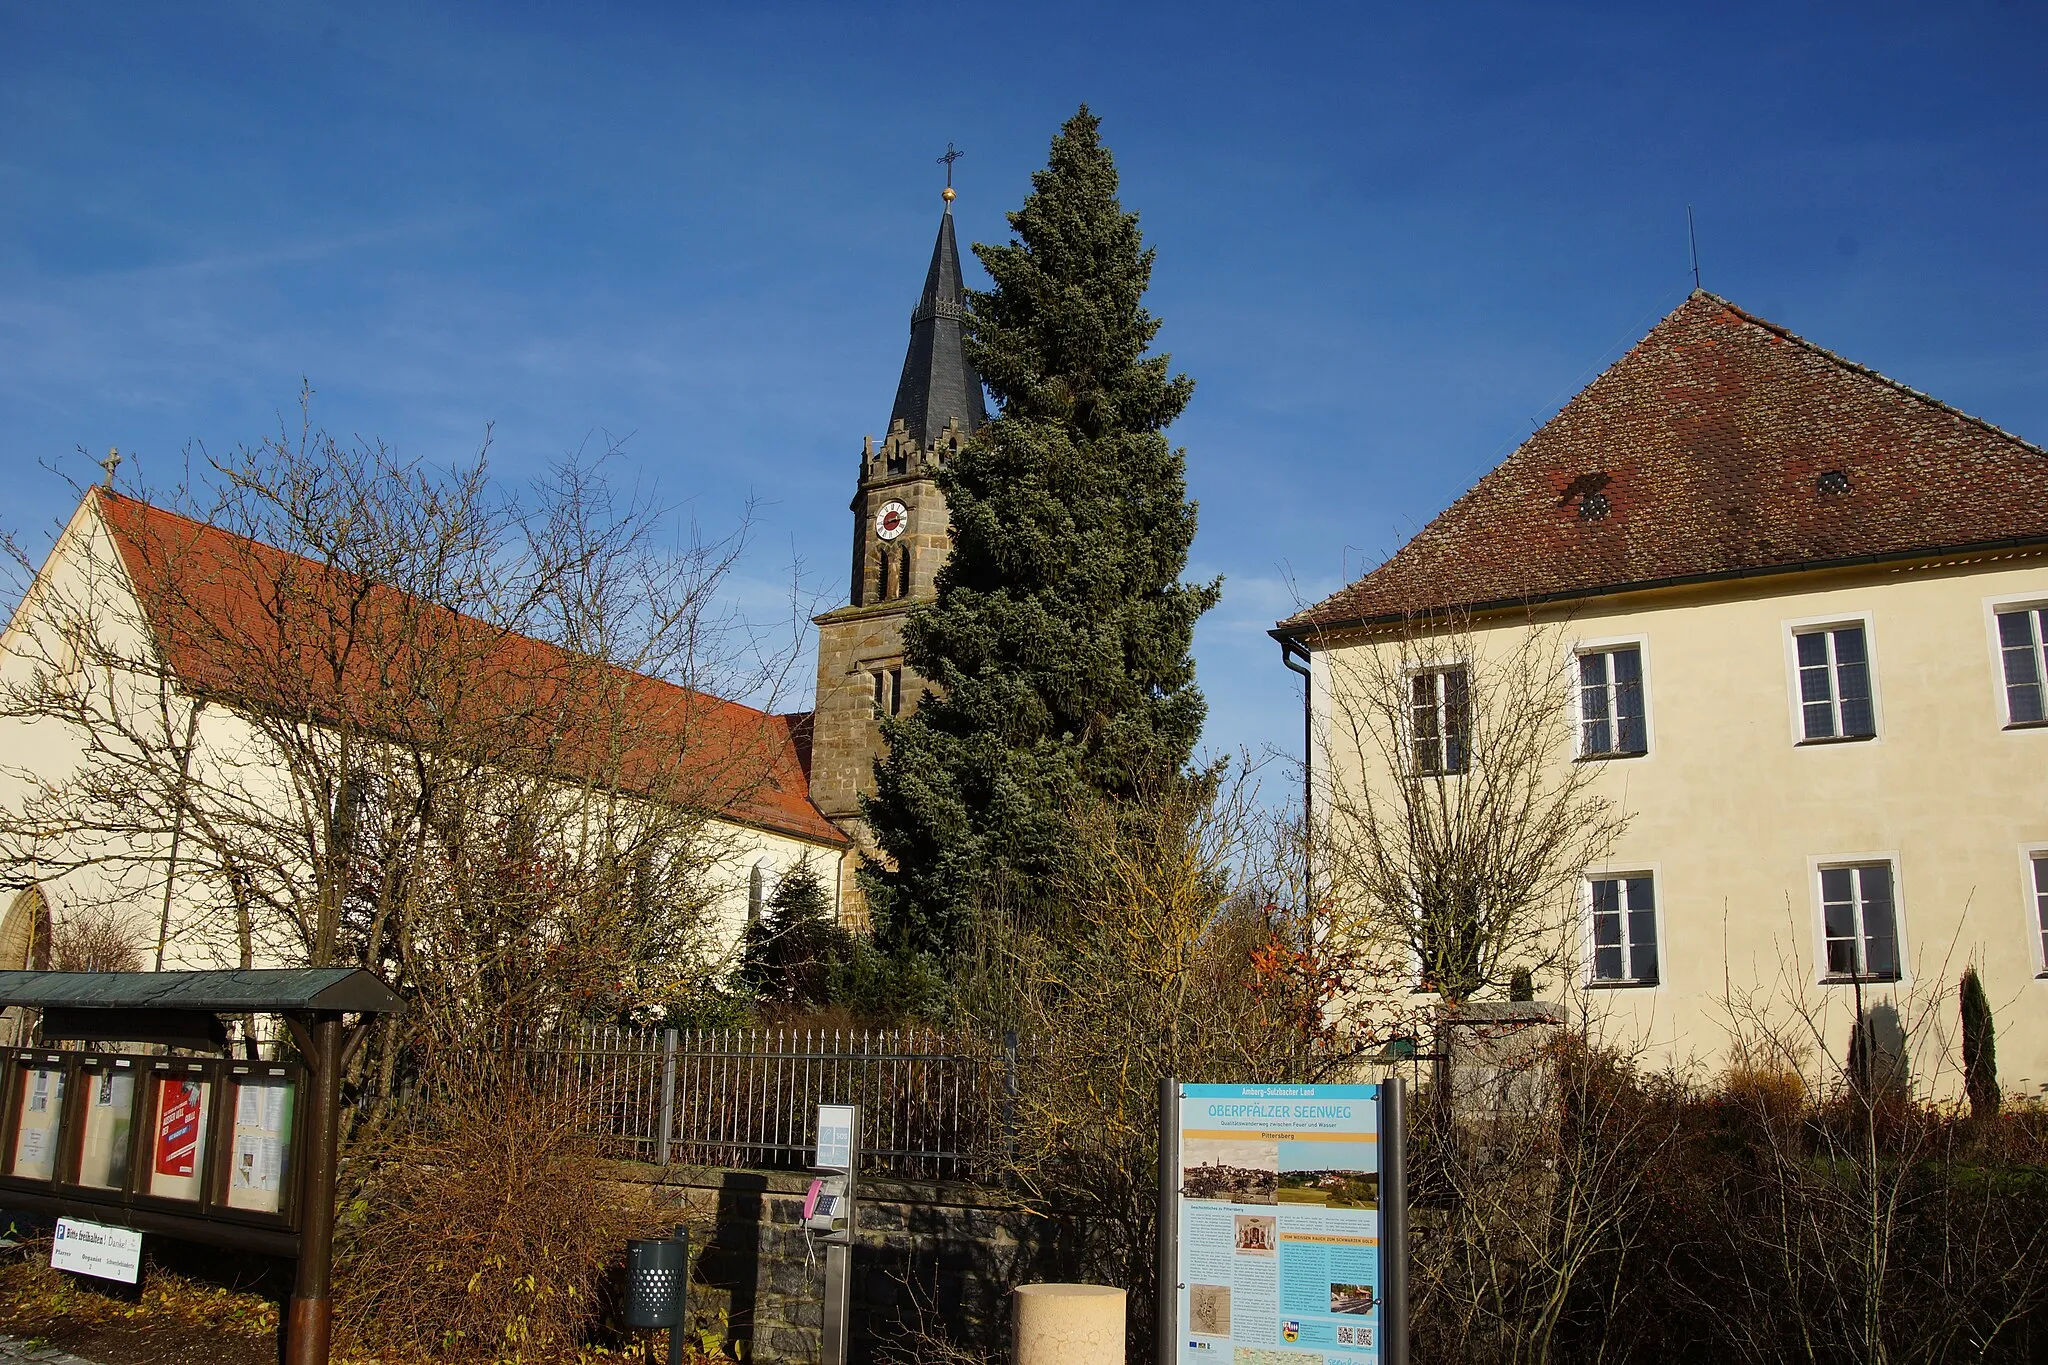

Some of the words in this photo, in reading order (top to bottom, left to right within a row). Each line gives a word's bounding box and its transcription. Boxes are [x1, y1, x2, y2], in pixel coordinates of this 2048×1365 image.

[1241, 1087, 1299, 1098] Amberg-Sulzbacher
[1300, 1088, 1315, 1096] Land
[1208, 1102, 1290, 1118] OBERPFÄLZER
[1294, 1105, 1352, 1119] SEENWEG
[1220, 1120, 1269, 1128] Qualitätswanderweg
[836, 1132, 847, 1140] SOS
[1261, 1132, 1295, 1140] Pittersberg
[67, 1228, 78, 1240] Bitte
